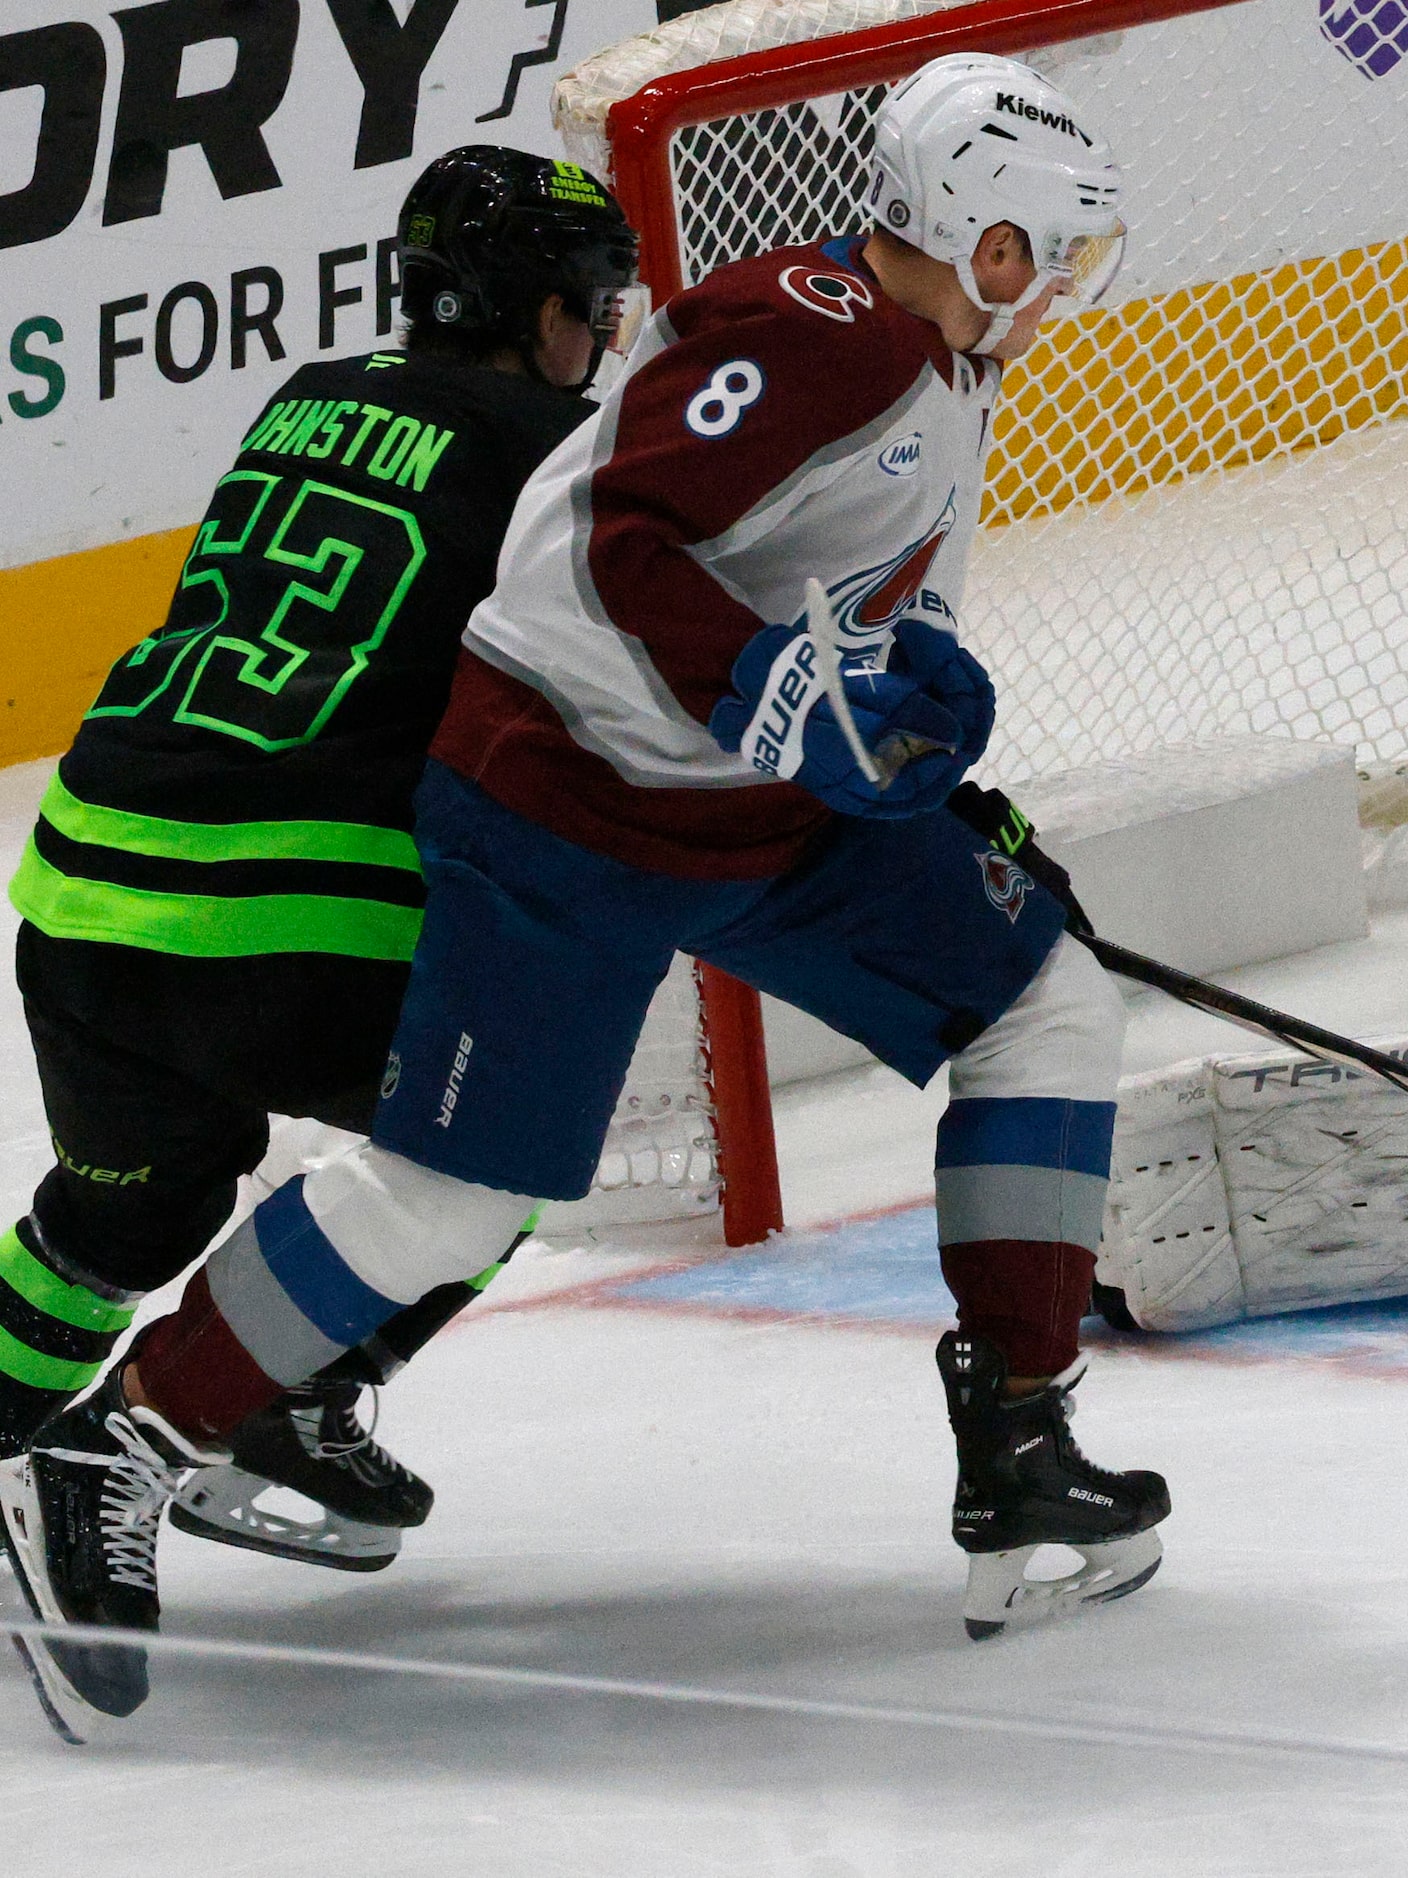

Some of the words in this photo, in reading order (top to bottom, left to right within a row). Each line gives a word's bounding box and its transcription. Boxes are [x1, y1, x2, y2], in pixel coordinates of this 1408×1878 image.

[996, 92, 1077, 137] Kiewit
[549, 187, 607, 208] TRANSFER
[551, 176, 597, 193] ENERGY
[99, 266, 286, 400] FOR
[685, 358, 766, 441] 8
[83, 469, 427, 753] 53
[753, 640, 817, 776] BAUER
[433, 1031, 473, 1128] BAUER
[1015, 1435, 1044, 1456] MACH
[1068, 1487, 1114, 1508] BAUER
